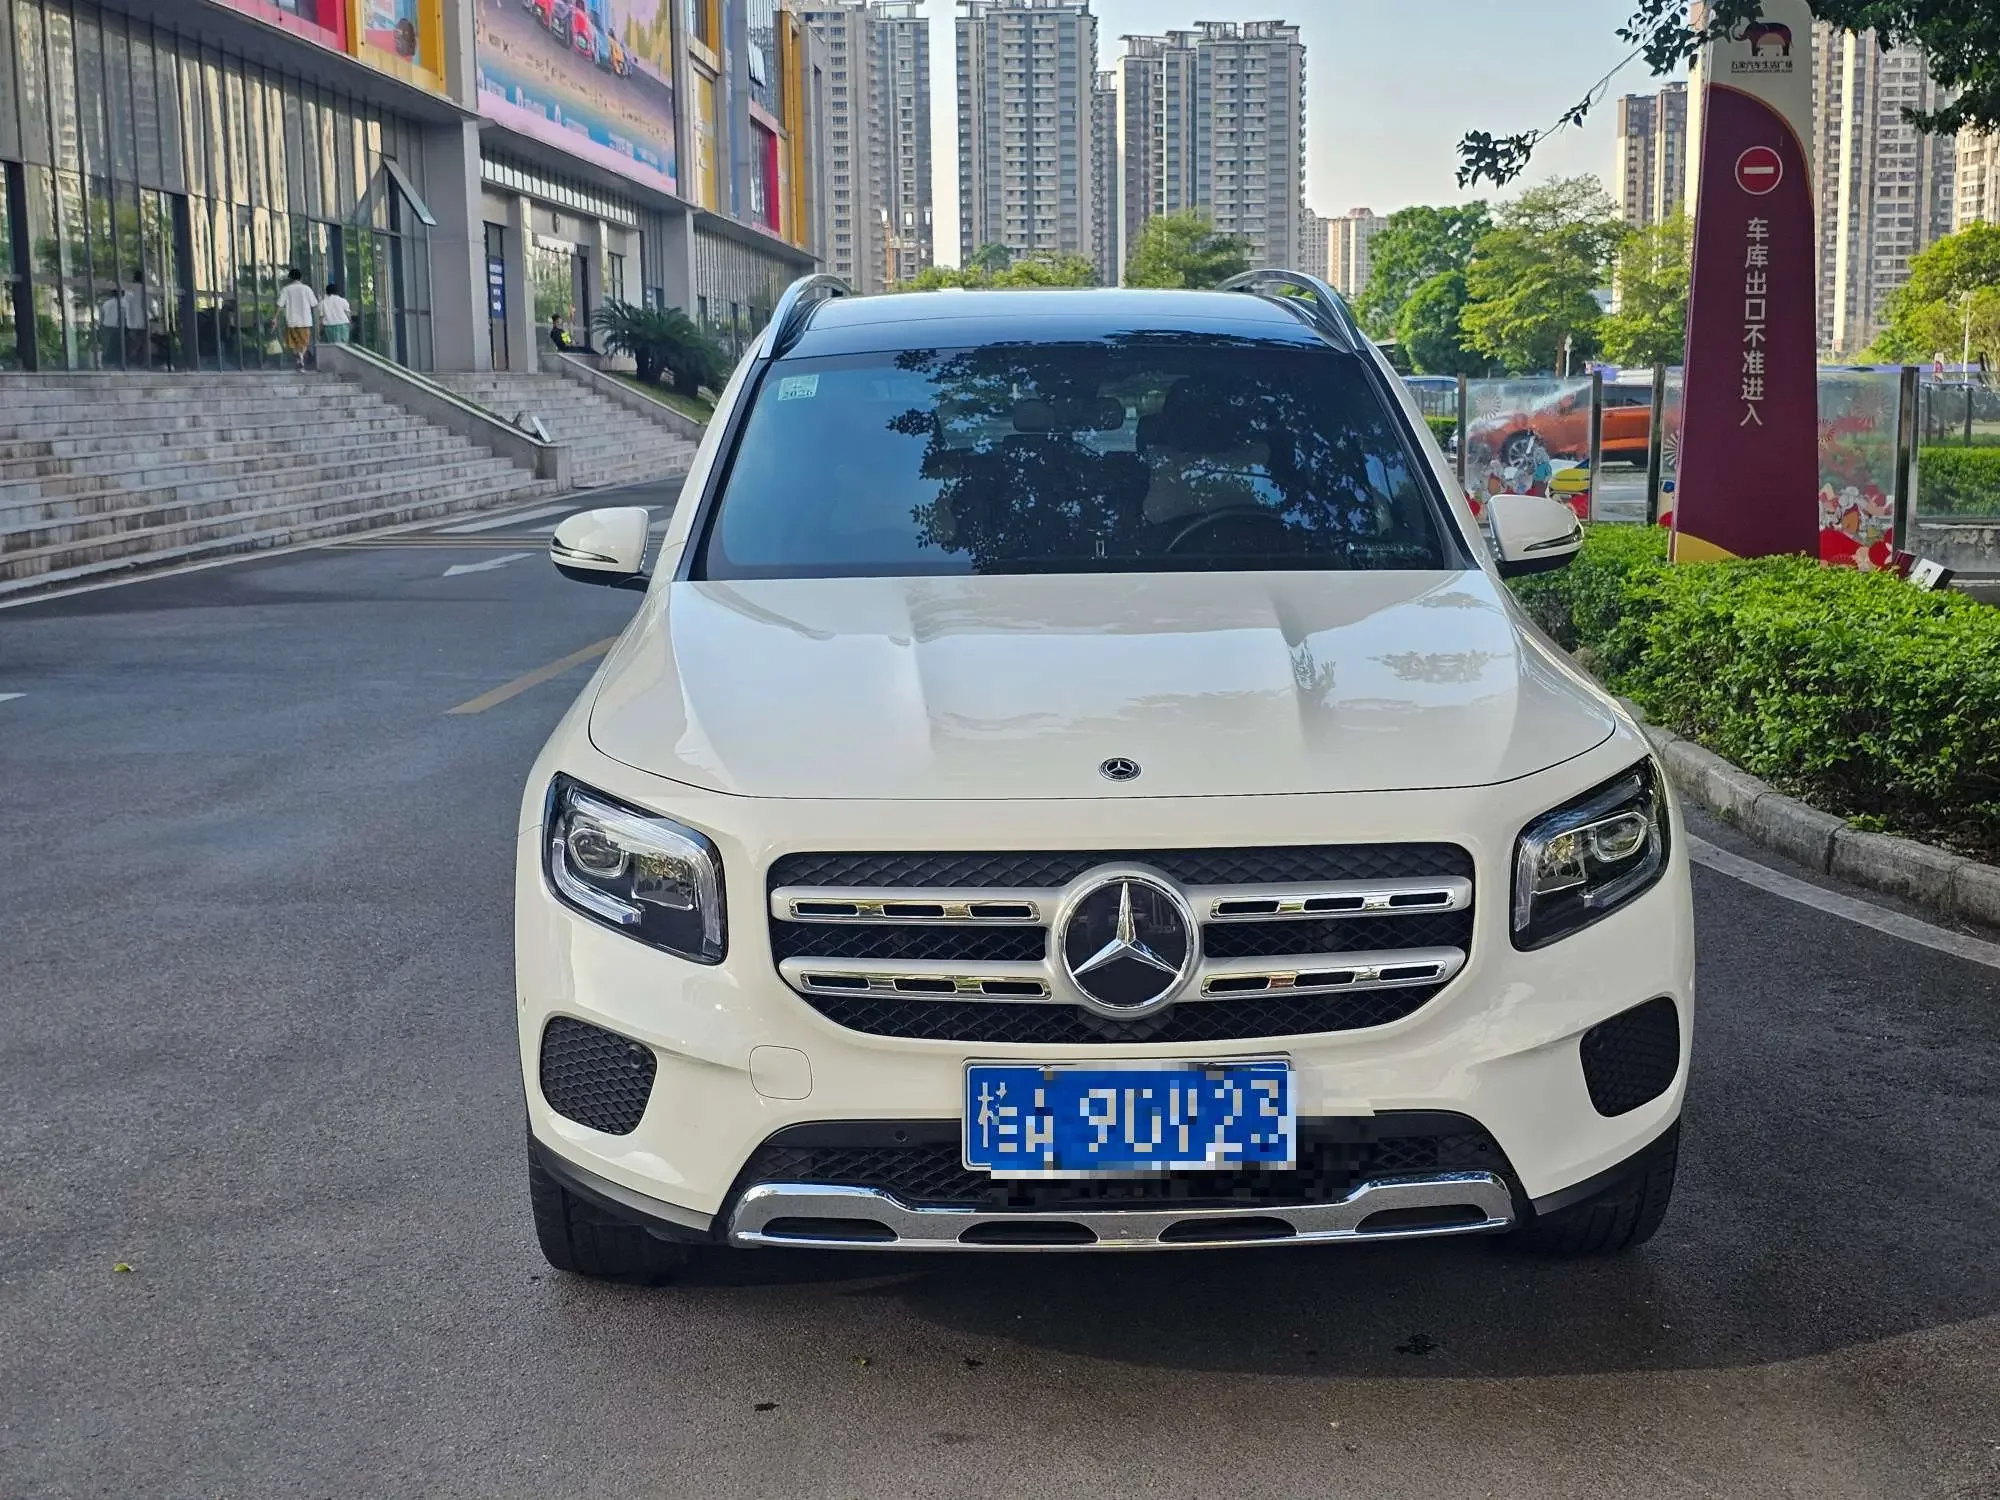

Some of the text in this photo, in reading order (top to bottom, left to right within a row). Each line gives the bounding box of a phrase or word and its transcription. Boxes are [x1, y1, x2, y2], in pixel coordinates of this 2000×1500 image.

[1740, 217, 1769, 426] 车库出口不准进入
